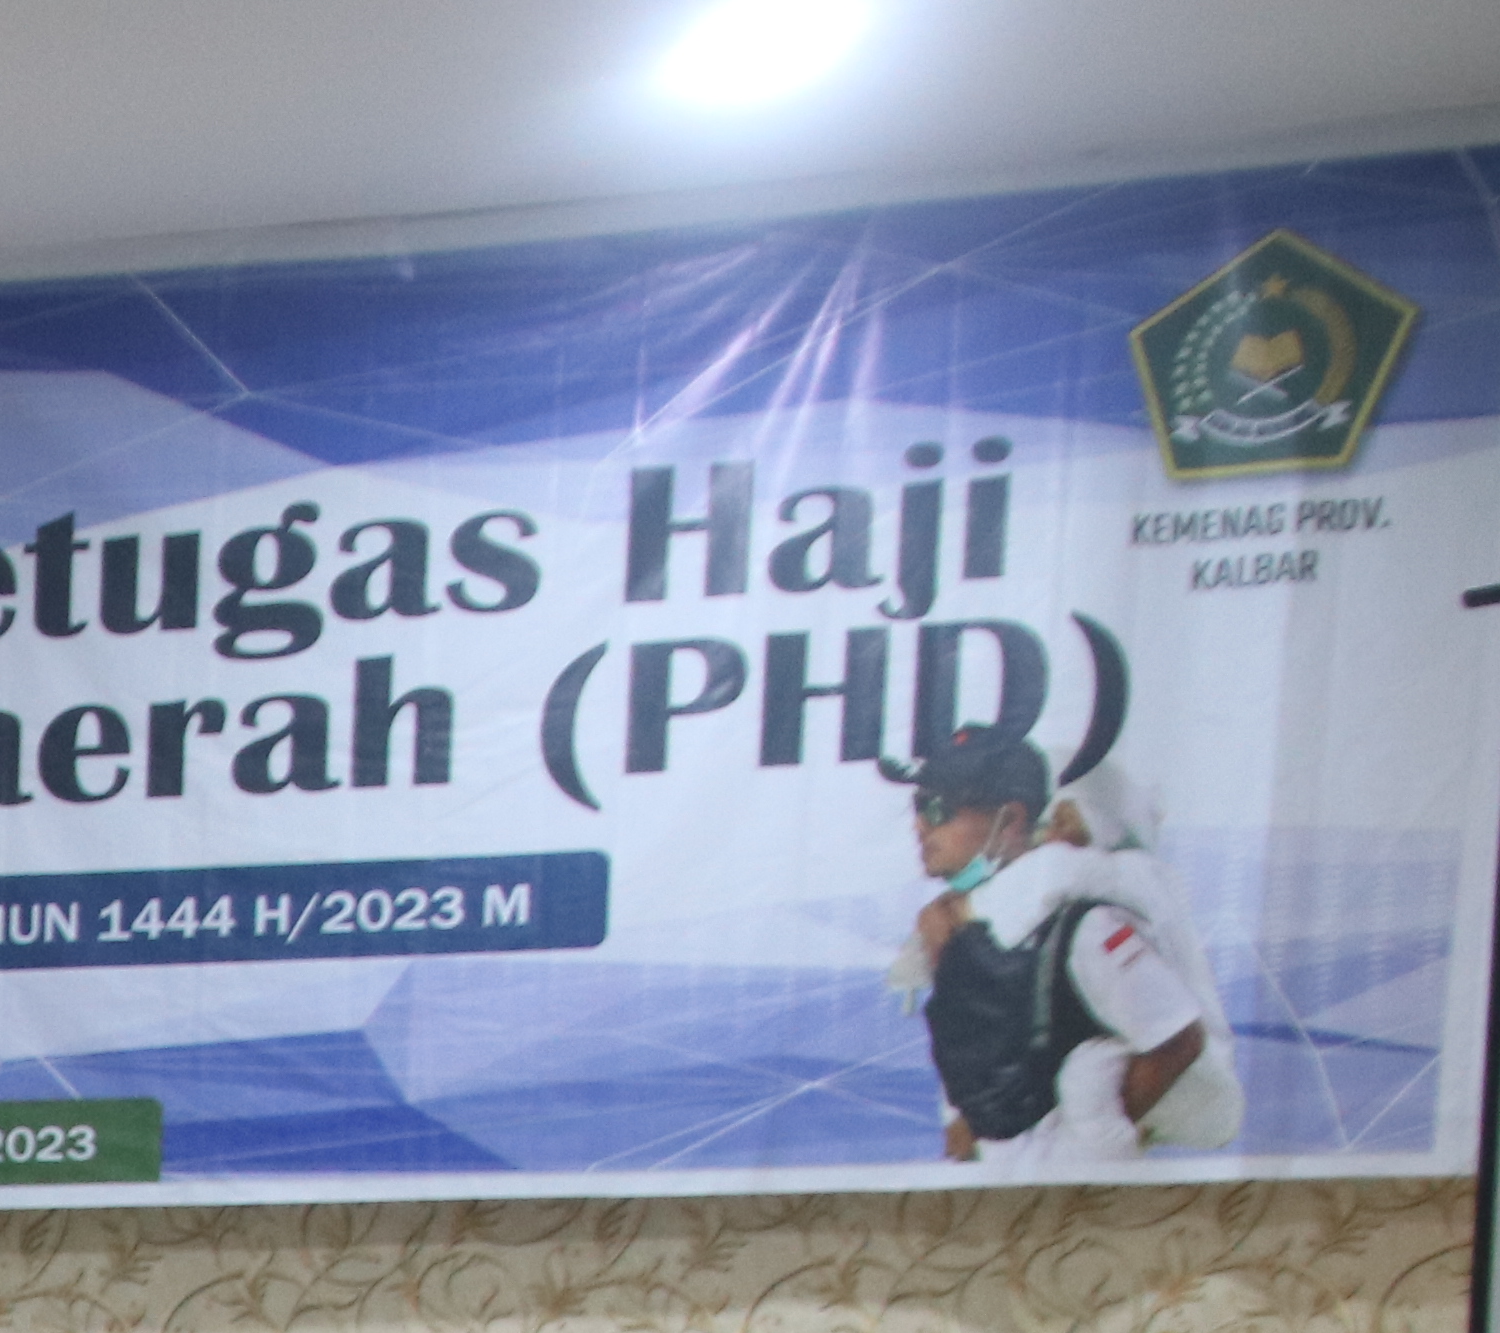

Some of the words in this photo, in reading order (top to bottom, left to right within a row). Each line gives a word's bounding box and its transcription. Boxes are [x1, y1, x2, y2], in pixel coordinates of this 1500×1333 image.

[622, 435, 1014, 619] Haji
[1130, 503, 1287, 545] KEMENAG
[1295, 497, 1393, 534] PROV.
[1191, 550, 1321, 590] KALBAR
[539, 610, 1132, 812] (PHD)
[97, 897, 236, 942] 1444
[254, 888, 466, 943] H/2023
[482, 883, 532, 926] M
